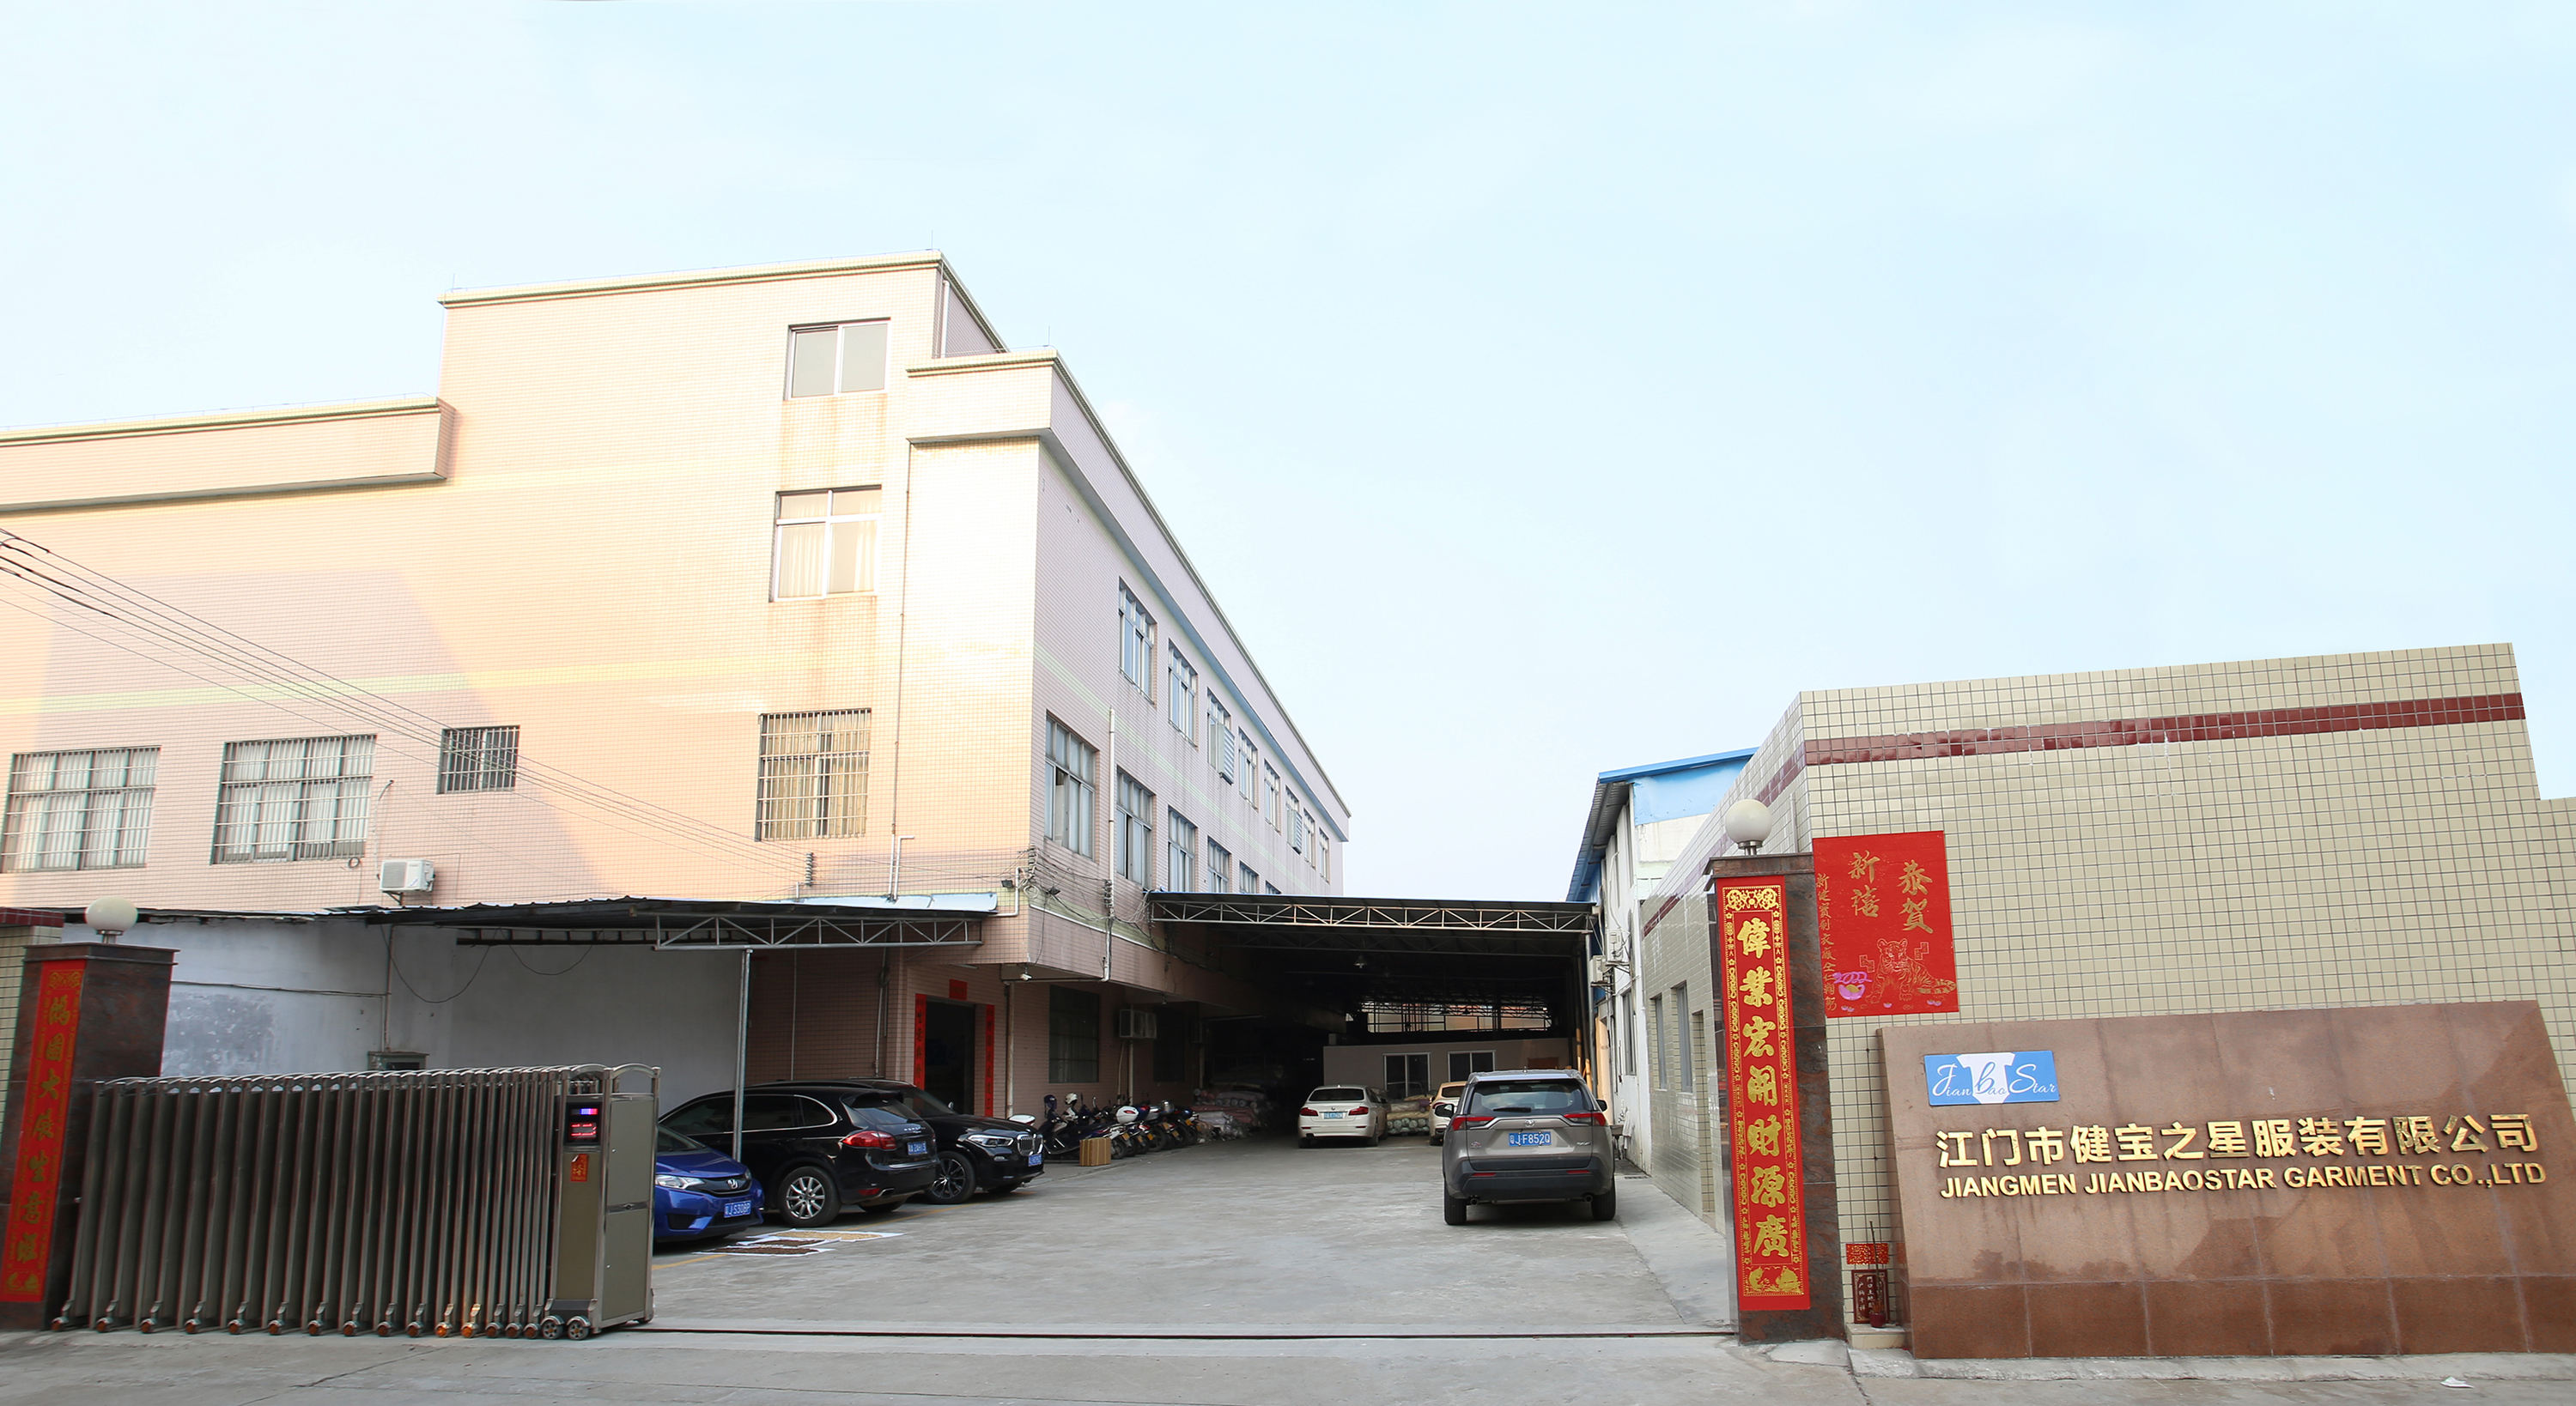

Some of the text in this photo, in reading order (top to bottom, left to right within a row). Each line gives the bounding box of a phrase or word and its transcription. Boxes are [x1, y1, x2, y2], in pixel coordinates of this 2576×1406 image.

[1848, 850, 1880, 918] 新禧
[1897, 859, 1933, 934] 恭賀
[1935, 1114, 2538, 1168] 江门市健宝之星服装有限公司
[1941, 1173, 2077, 1198] JIANGMEN
[2084, 1168, 2278, 1194] JIANBAOSTAR
[2283, 1165, 2423, 1188] GARMENT
